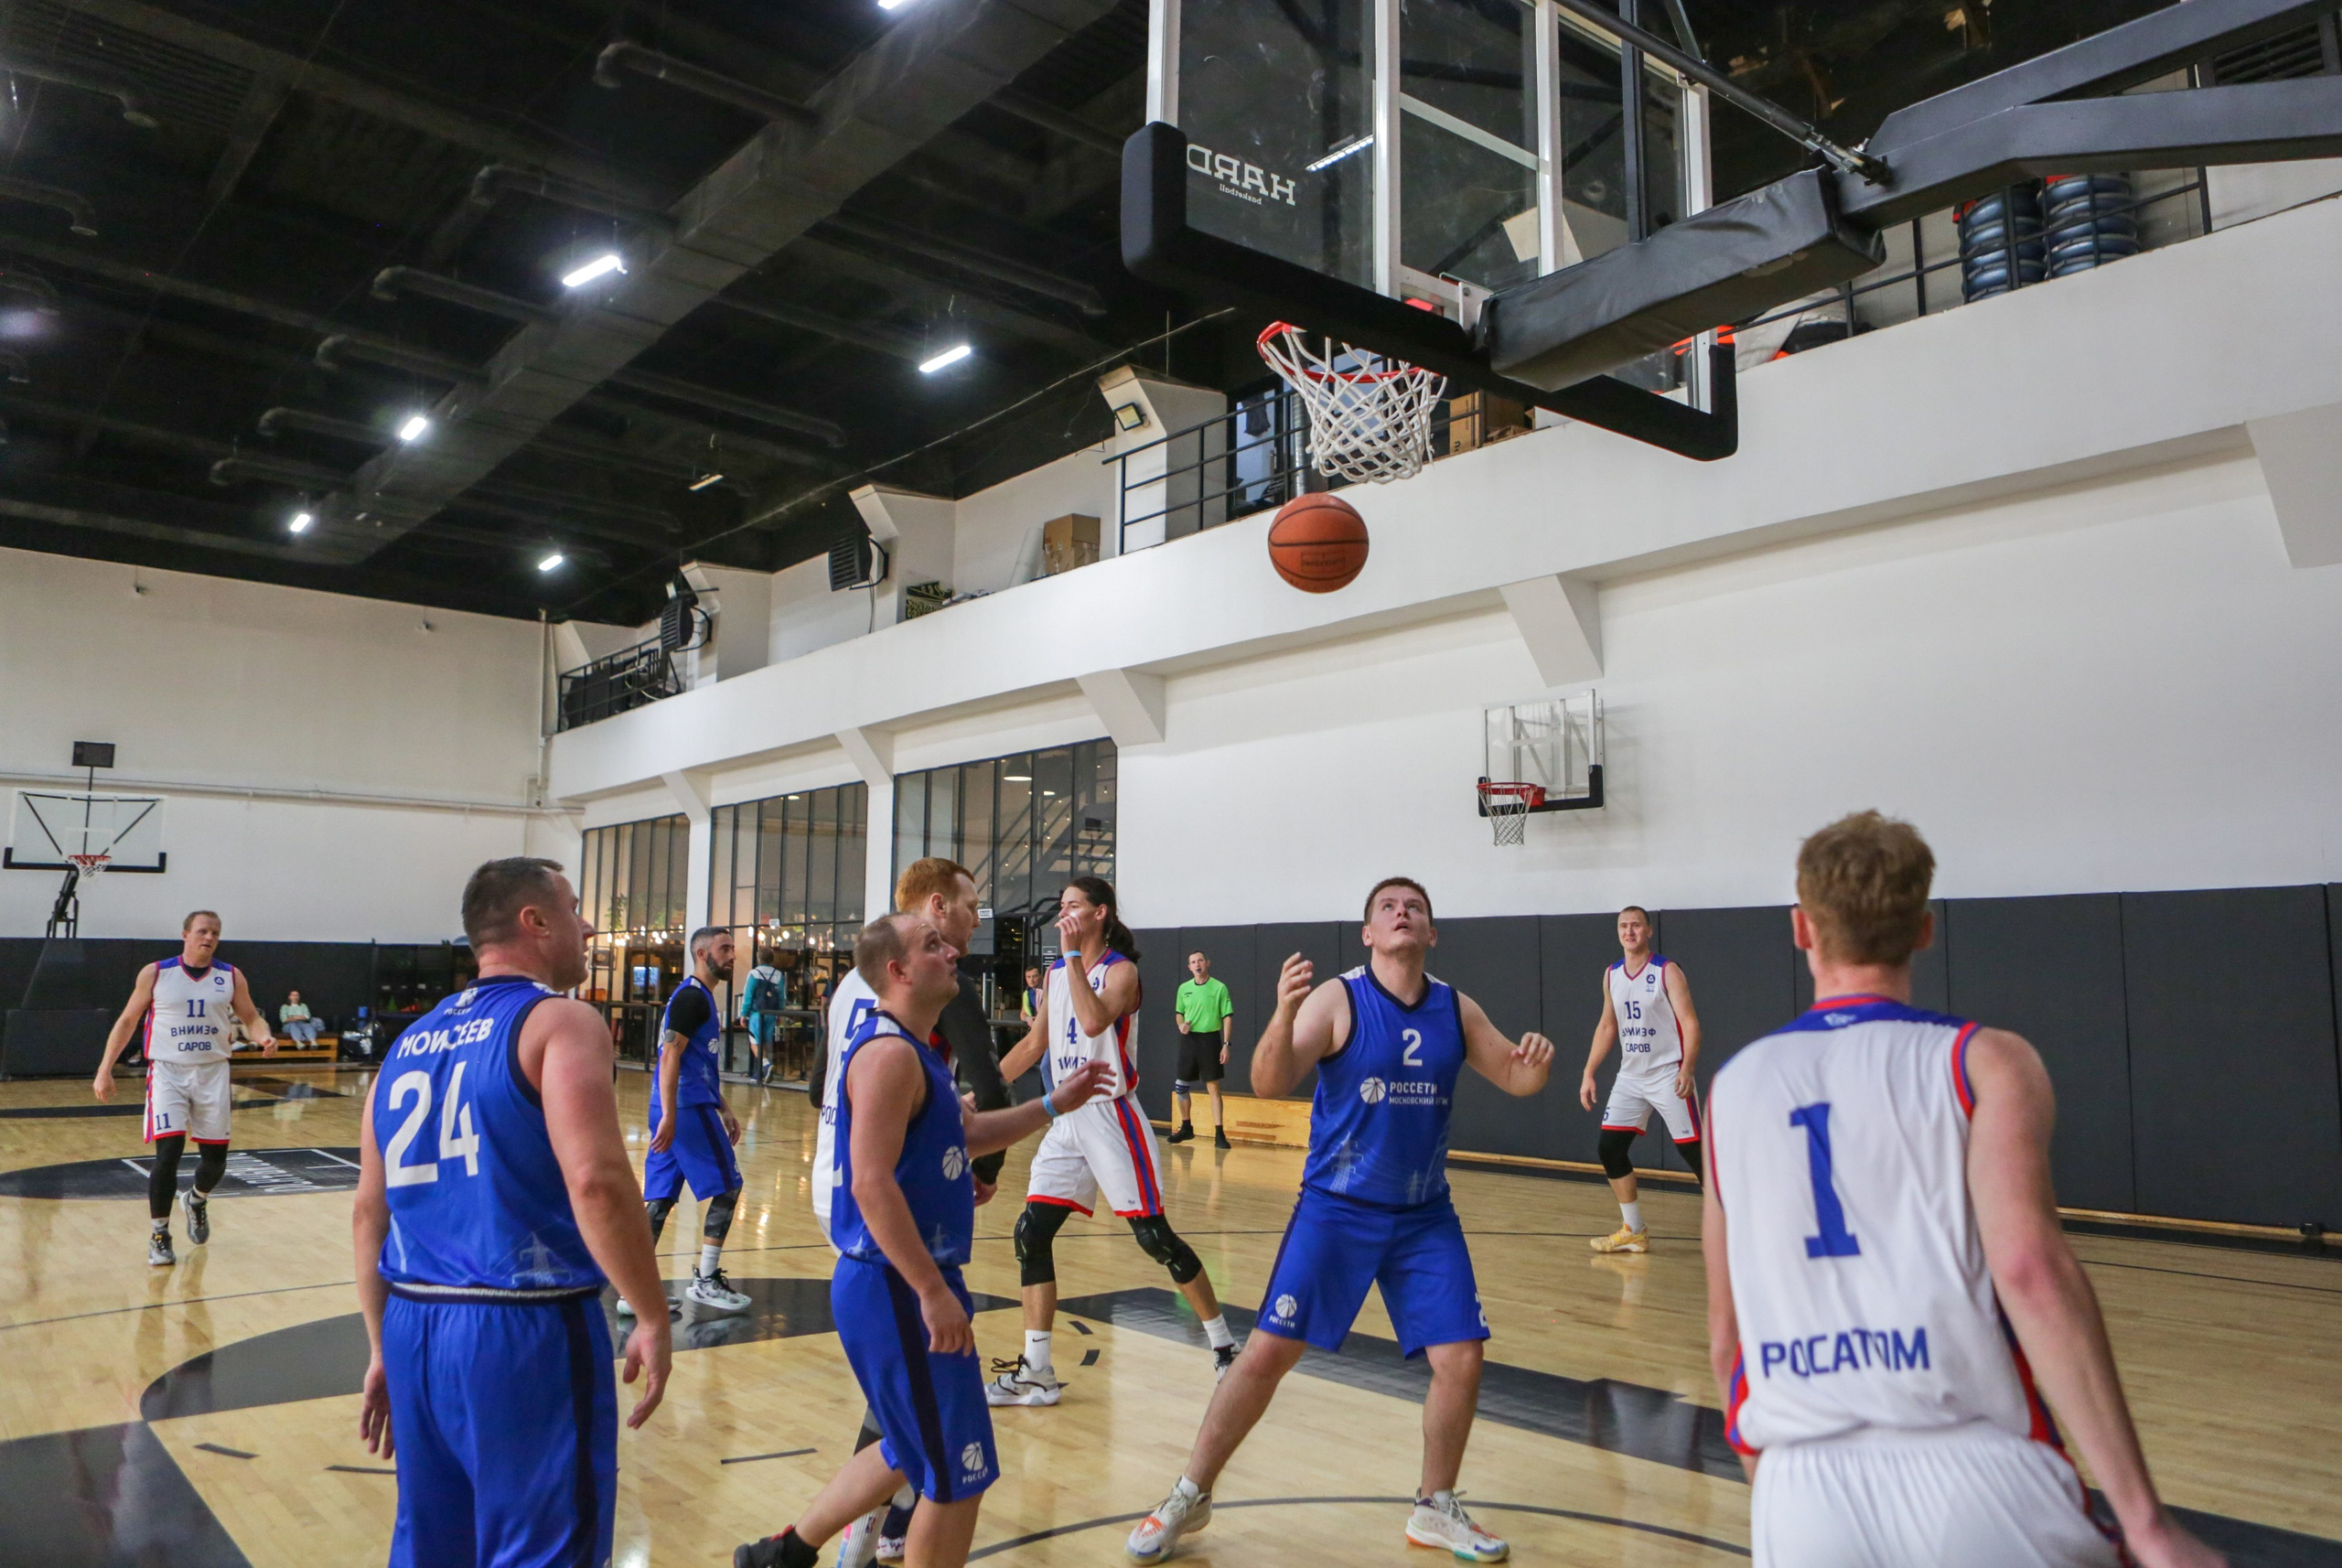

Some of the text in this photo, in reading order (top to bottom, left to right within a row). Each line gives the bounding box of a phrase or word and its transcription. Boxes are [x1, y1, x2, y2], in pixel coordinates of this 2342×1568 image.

[187, 999, 206, 1017] 11
[1625, 1001, 1641, 1019] 15
[170, 1025, 219, 1036] ВНИИЭФ
[396, 1017, 495, 1059] МОИСЕЕВ
[1067, 1017, 1078, 1045] 4
[177, 1042, 212, 1052] САРОВ
[1402, 1028, 1423, 1067] 2
[1626, 1043, 1651, 1053] САРОВ
[1390, 1082, 1438, 1095] РОССЕТИ
[1389, 1096, 1434, 1105] МОСКОВСКИЙ
[155, 1112, 172, 1131] 11
[384, 1060, 480, 1189] 24
[1789, 1101, 1862, 1259] 1
[1760, 1326, 1930, 1379] РОСАТОМ
